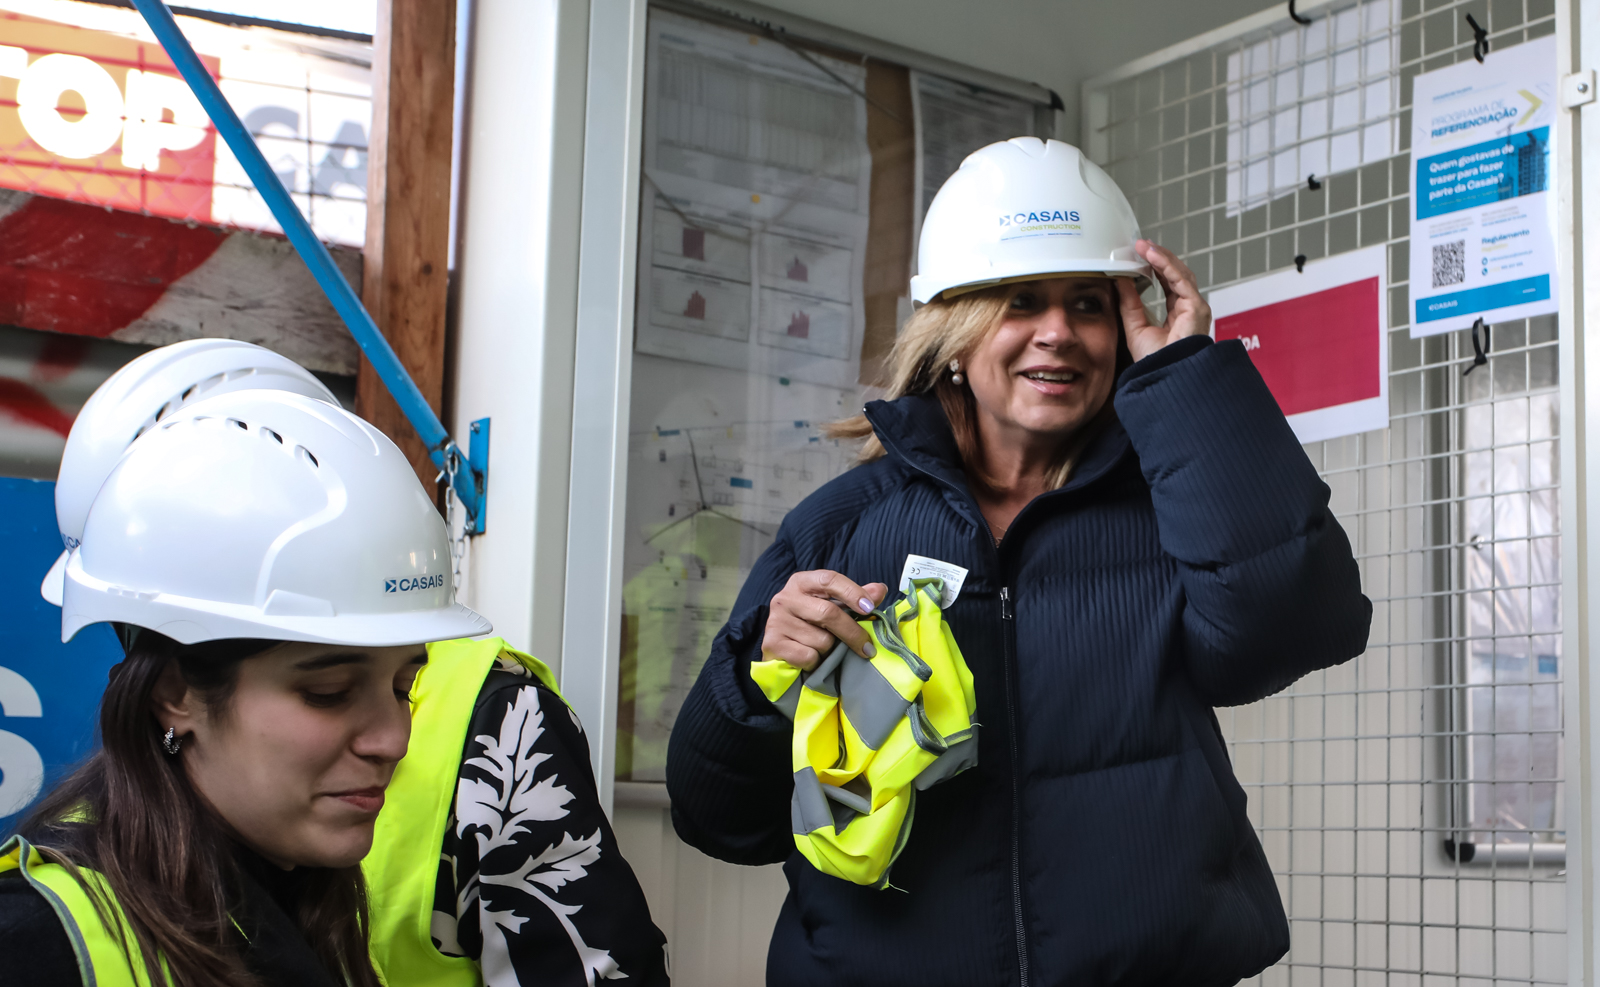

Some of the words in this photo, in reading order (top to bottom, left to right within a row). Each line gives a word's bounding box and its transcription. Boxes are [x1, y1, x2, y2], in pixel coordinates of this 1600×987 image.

[1431, 103, 1490, 126] PROGRAMA
[1431, 106, 1518, 138] REFERENCIAÇÃO
[1429, 159, 1458, 173] Quem
[1458, 148, 1501, 168] gostavas
[1501, 144, 1515, 155] de
[1429, 173, 1457, 186] trazer
[1456, 167, 1479, 181] para
[1479, 160, 1504, 173] fazer
[1429, 187, 1454, 201] parte
[1454, 183, 1467, 194] da
[1467, 172, 1504, 191] Casais?
[1013, 210, 1081, 225] CASAIS
[1020, 223, 1081, 232] CONSTRUCTION
[1481, 229, 1530, 244] Regulamento
[399, 574, 444, 592] CASAIS
